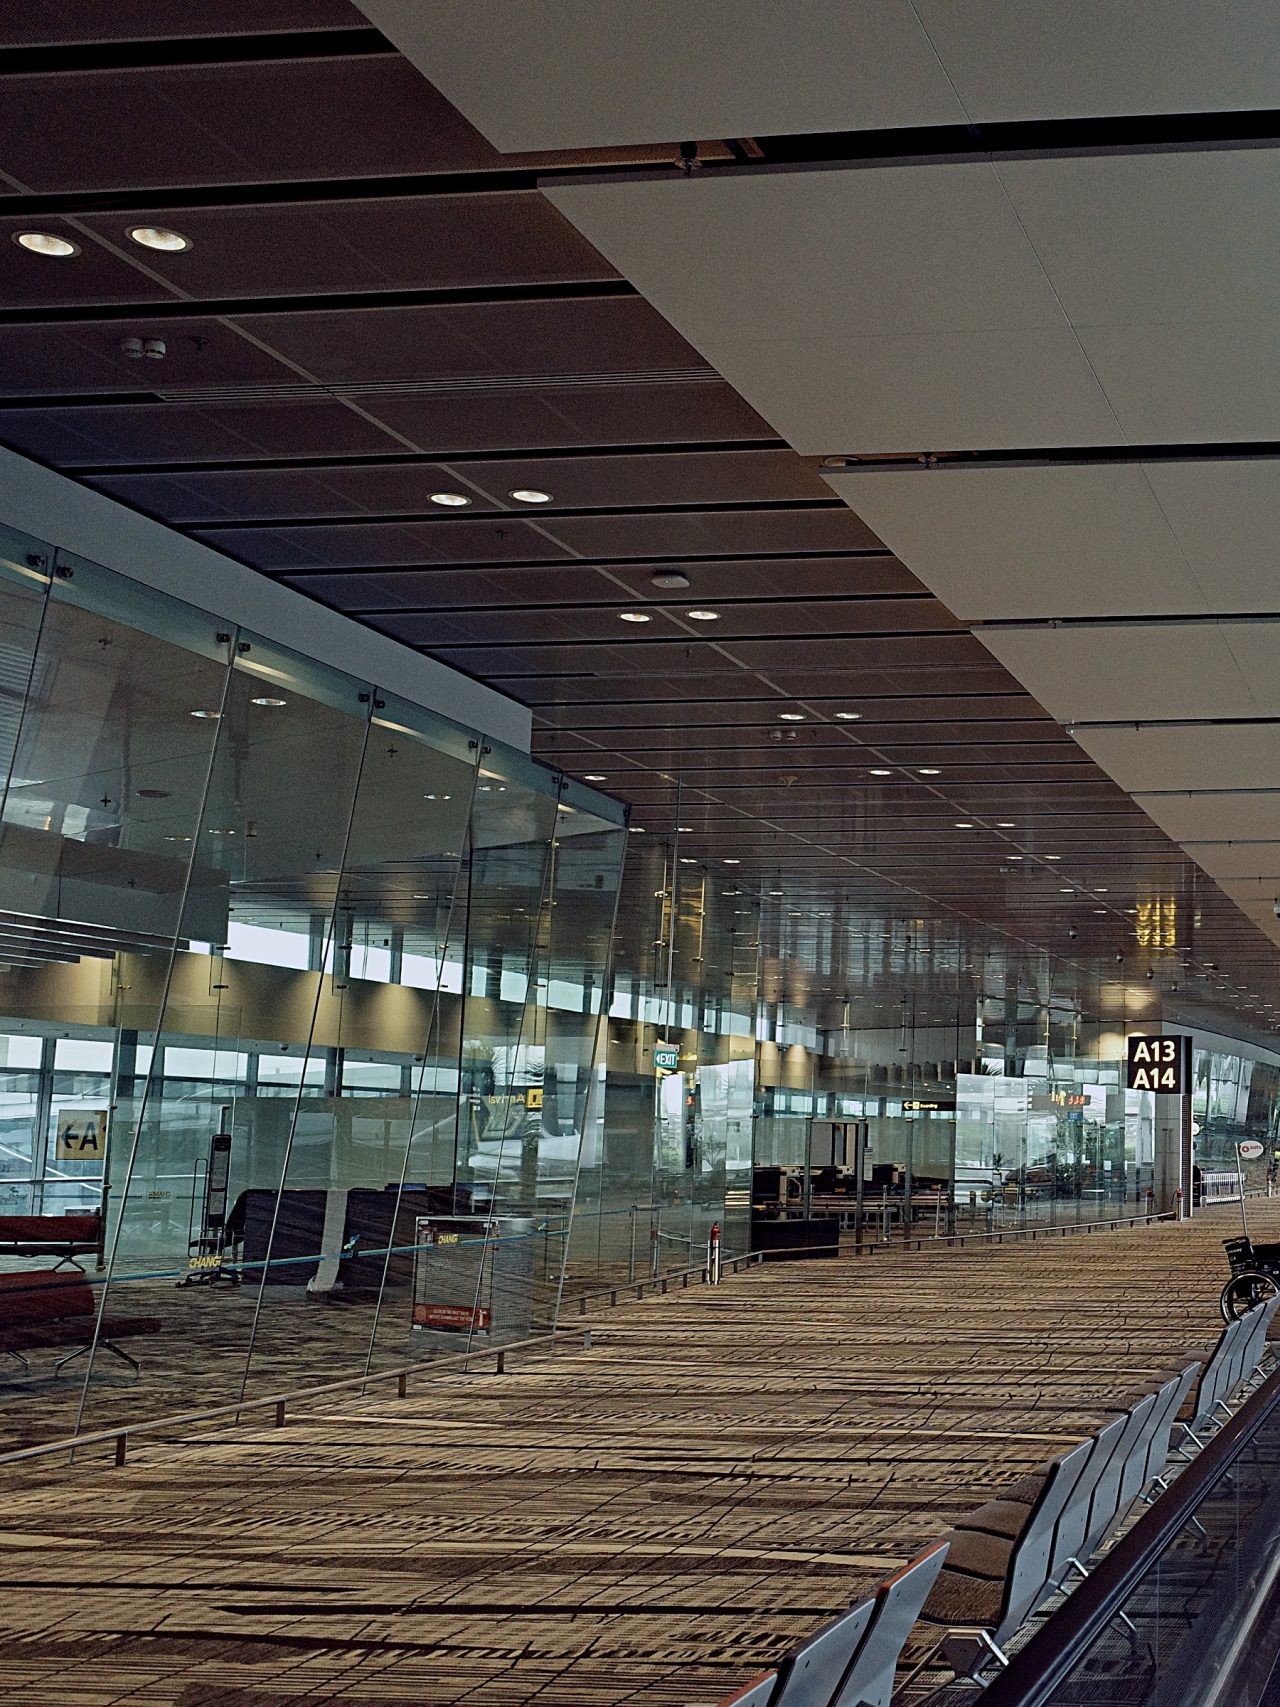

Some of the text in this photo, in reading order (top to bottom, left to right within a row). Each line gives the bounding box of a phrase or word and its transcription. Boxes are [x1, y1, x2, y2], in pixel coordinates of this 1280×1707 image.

[660, 1053, 676, 1065] EXIT
[1133, 1040, 1176, 1063] A13
[1132, 1067, 1176, 1089] A14
